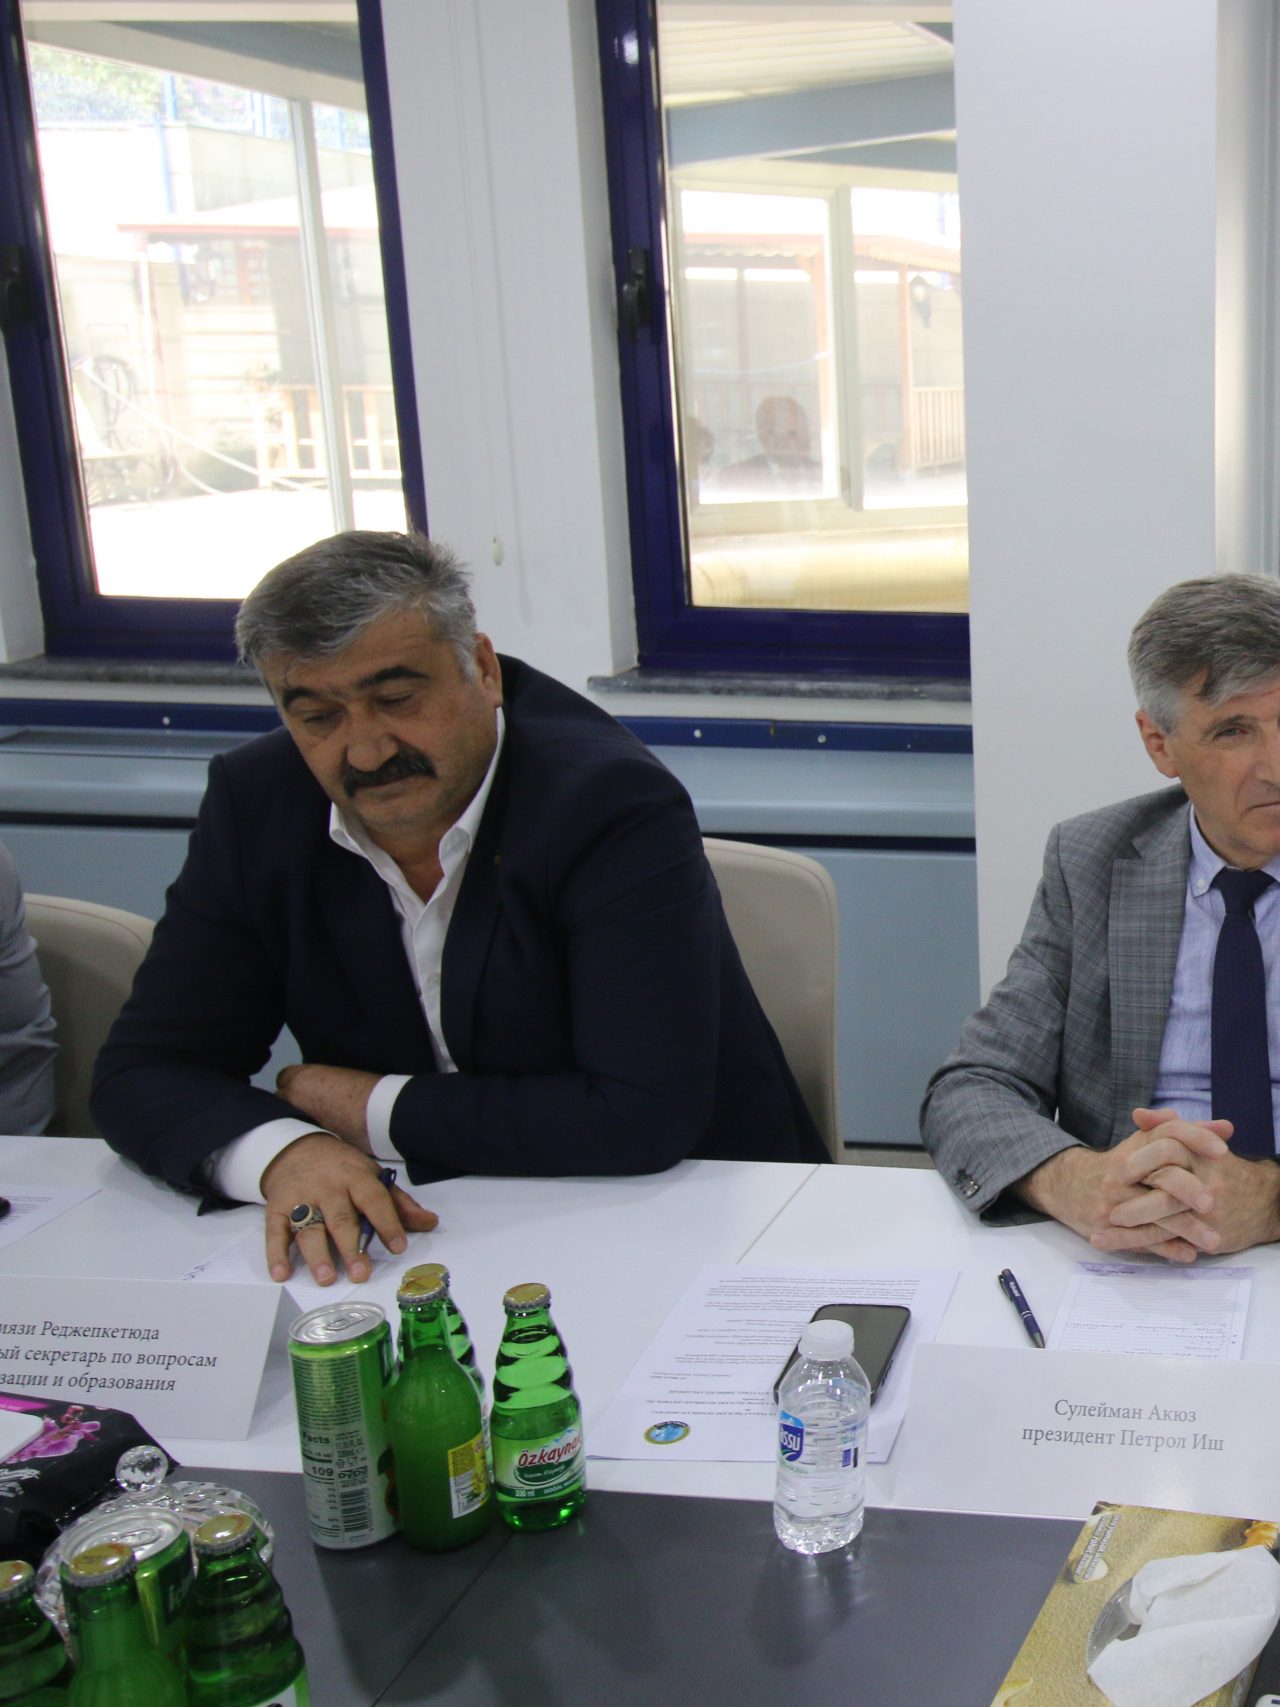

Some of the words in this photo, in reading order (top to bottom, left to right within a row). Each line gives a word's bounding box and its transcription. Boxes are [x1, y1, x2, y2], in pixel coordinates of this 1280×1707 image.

[40, 1320, 160, 1341] Реджепкетюда
[25, 1349, 107, 1368] секретарь
[111, 1352, 132, 1364] по
[136, 1353, 218, 1371] вопросам
[0, 1373, 48, 1388] зации
[52, 1375, 63, 1387] и
[68, 1371, 176, 1393] образования
[1054, 1399, 1144, 1421] Сулейман
[1148, 1404, 1197, 1423] Акюз
[1021, 1427, 1115, 1446] президент
[1120, 1429, 1187, 1453] Петрол
[1192, 1433, 1225, 1451] Иш
[312, 1466, 334, 1477] 109
